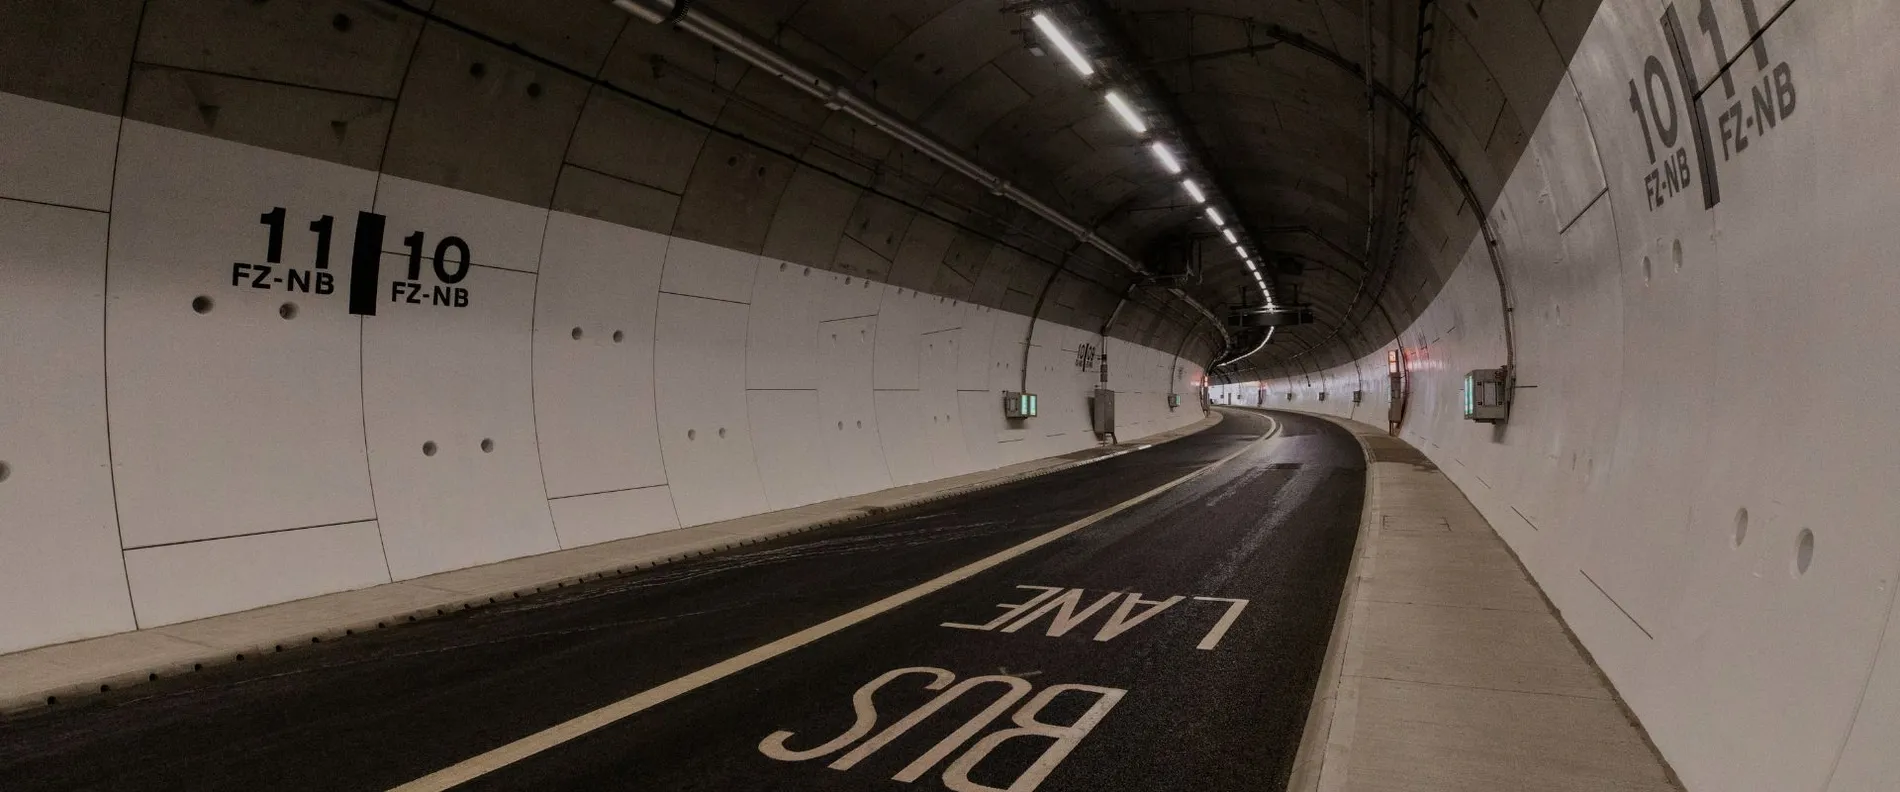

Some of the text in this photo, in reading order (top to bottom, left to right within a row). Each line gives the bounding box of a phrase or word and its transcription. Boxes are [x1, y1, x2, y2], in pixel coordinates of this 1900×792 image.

[1628, 55, 1678, 165] 10
[1718, 61, 1797, 162] FZ-NB
[1644, 147, 1691, 212] FZ-NB
[260, 207, 335, 269] 11
[403, 230, 471, 285] 10
[231, 263, 335, 295] FZ-NB
[391, 281, 469, 308] FZ-NB
[940, 584, 1250, 650] LANE
[758, 666, 1129, 792] BUS
